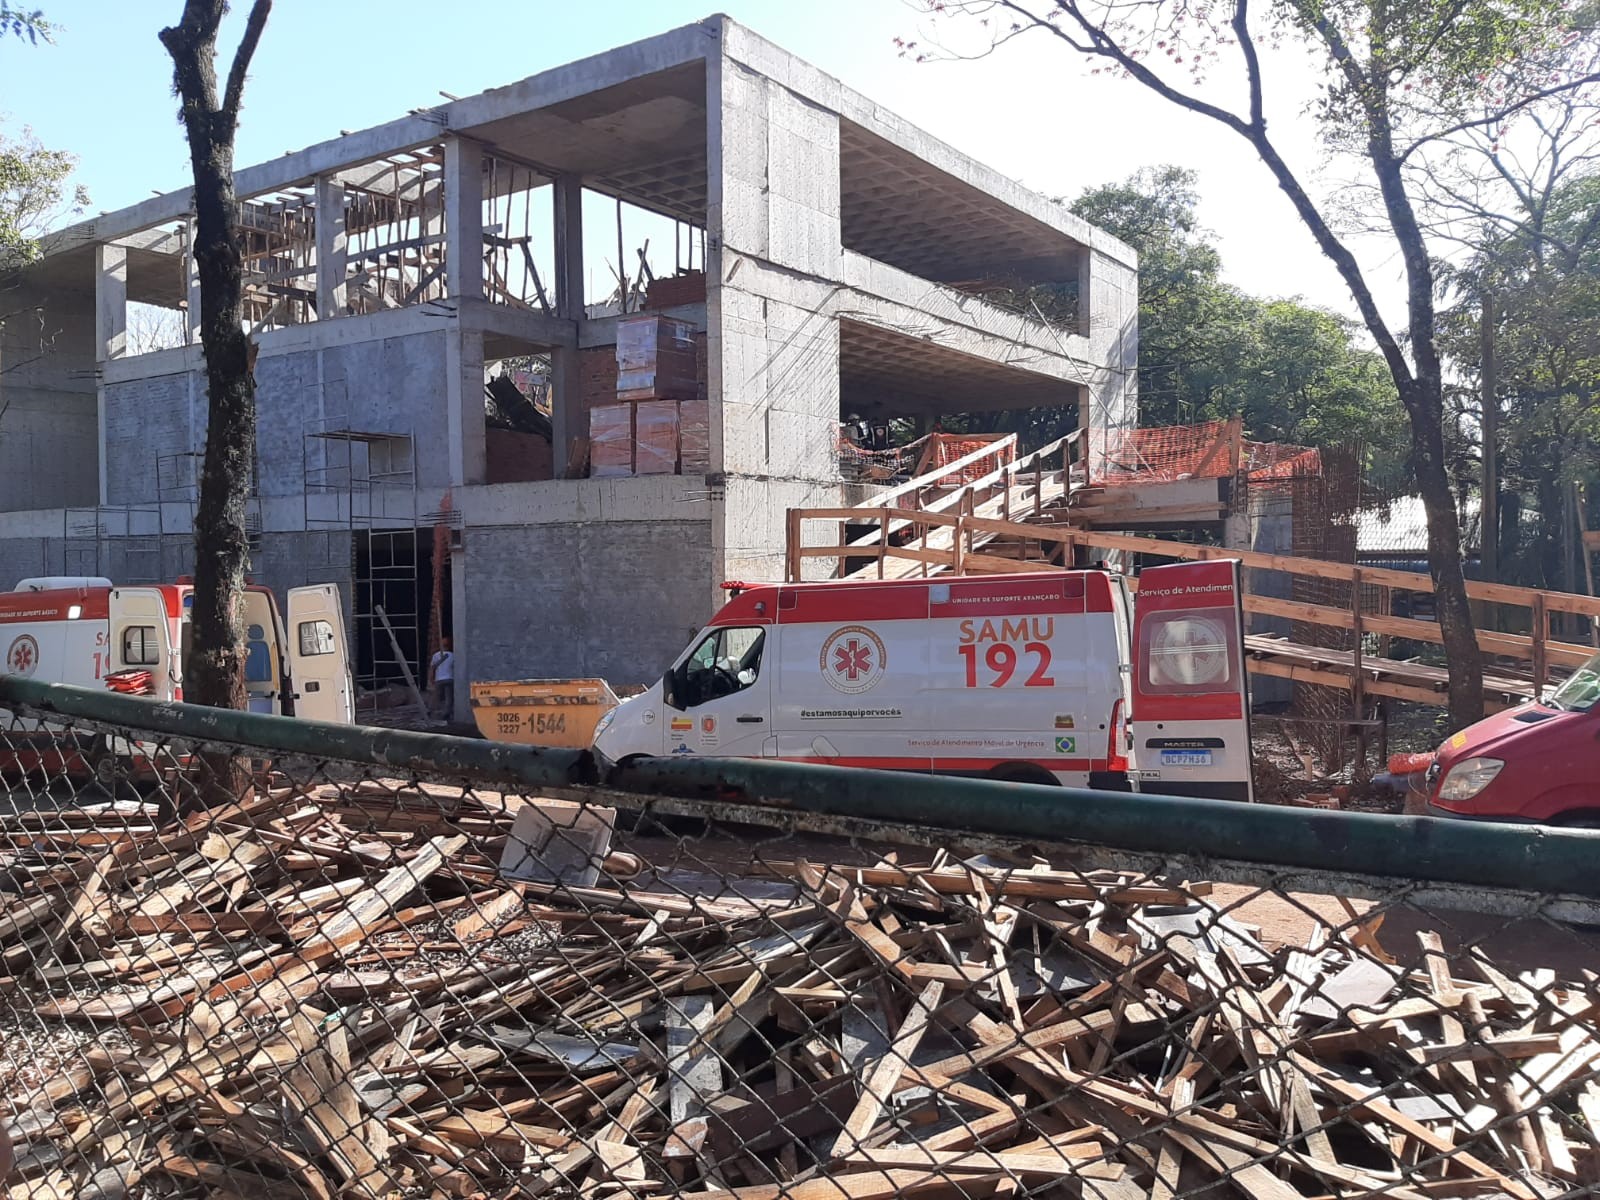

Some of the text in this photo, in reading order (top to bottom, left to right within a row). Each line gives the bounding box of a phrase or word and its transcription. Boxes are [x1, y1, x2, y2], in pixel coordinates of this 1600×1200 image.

[1140, 589, 1170, 597] Serviço
[1172, 586, 1183, 595] de
[952, 597, 981, 605] UNIDADE
[1023, 593, 1060, 601] AVANÇADO
[959, 617, 1054, 644] SAMU
[958, 642, 1055, 688] 192
[497, 712, 520, 722] 3026
